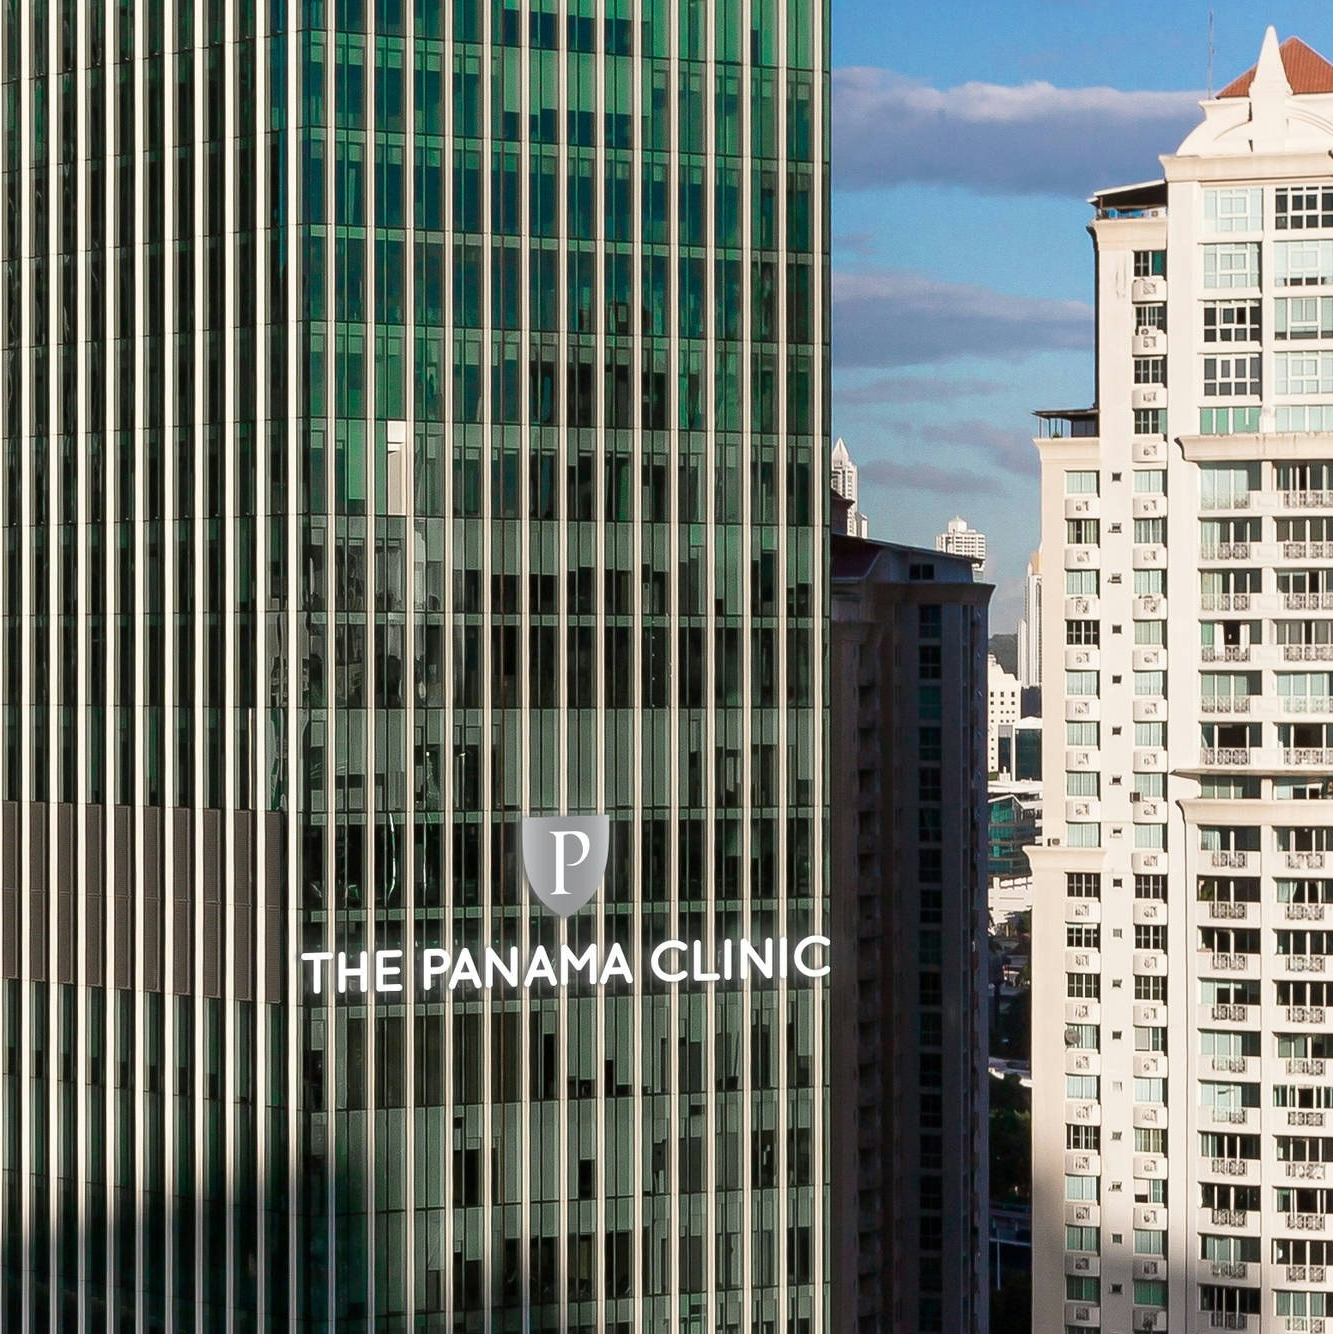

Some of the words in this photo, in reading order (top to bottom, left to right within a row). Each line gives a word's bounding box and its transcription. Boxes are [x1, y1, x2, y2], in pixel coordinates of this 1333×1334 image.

[549, 830, 591, 895] P
[300, 949, 404, 994] THE
[422, 942, 634, 991] PANAMA
[650, 935, 831, 982] CLINIC
